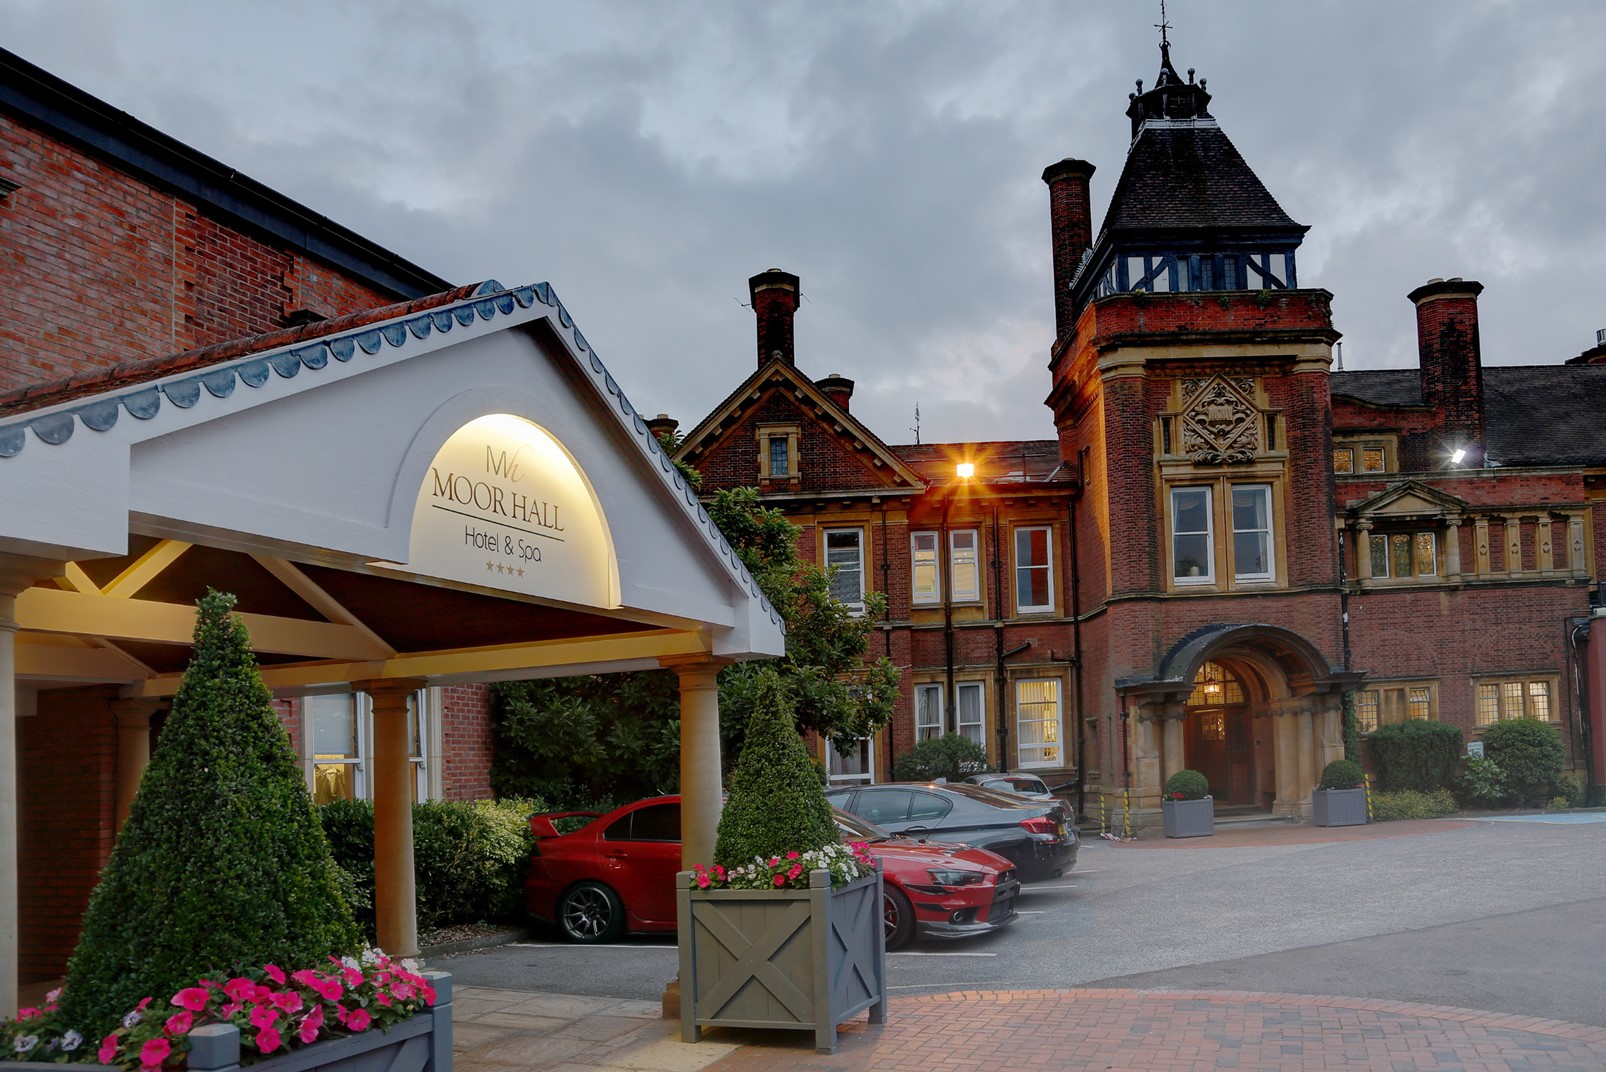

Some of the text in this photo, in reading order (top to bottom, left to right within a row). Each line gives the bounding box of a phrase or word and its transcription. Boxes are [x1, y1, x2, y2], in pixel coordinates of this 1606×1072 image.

[432, 467, 565, 532] MOOR HALL
[465, 525, 542, 563] Hotel & Spa
